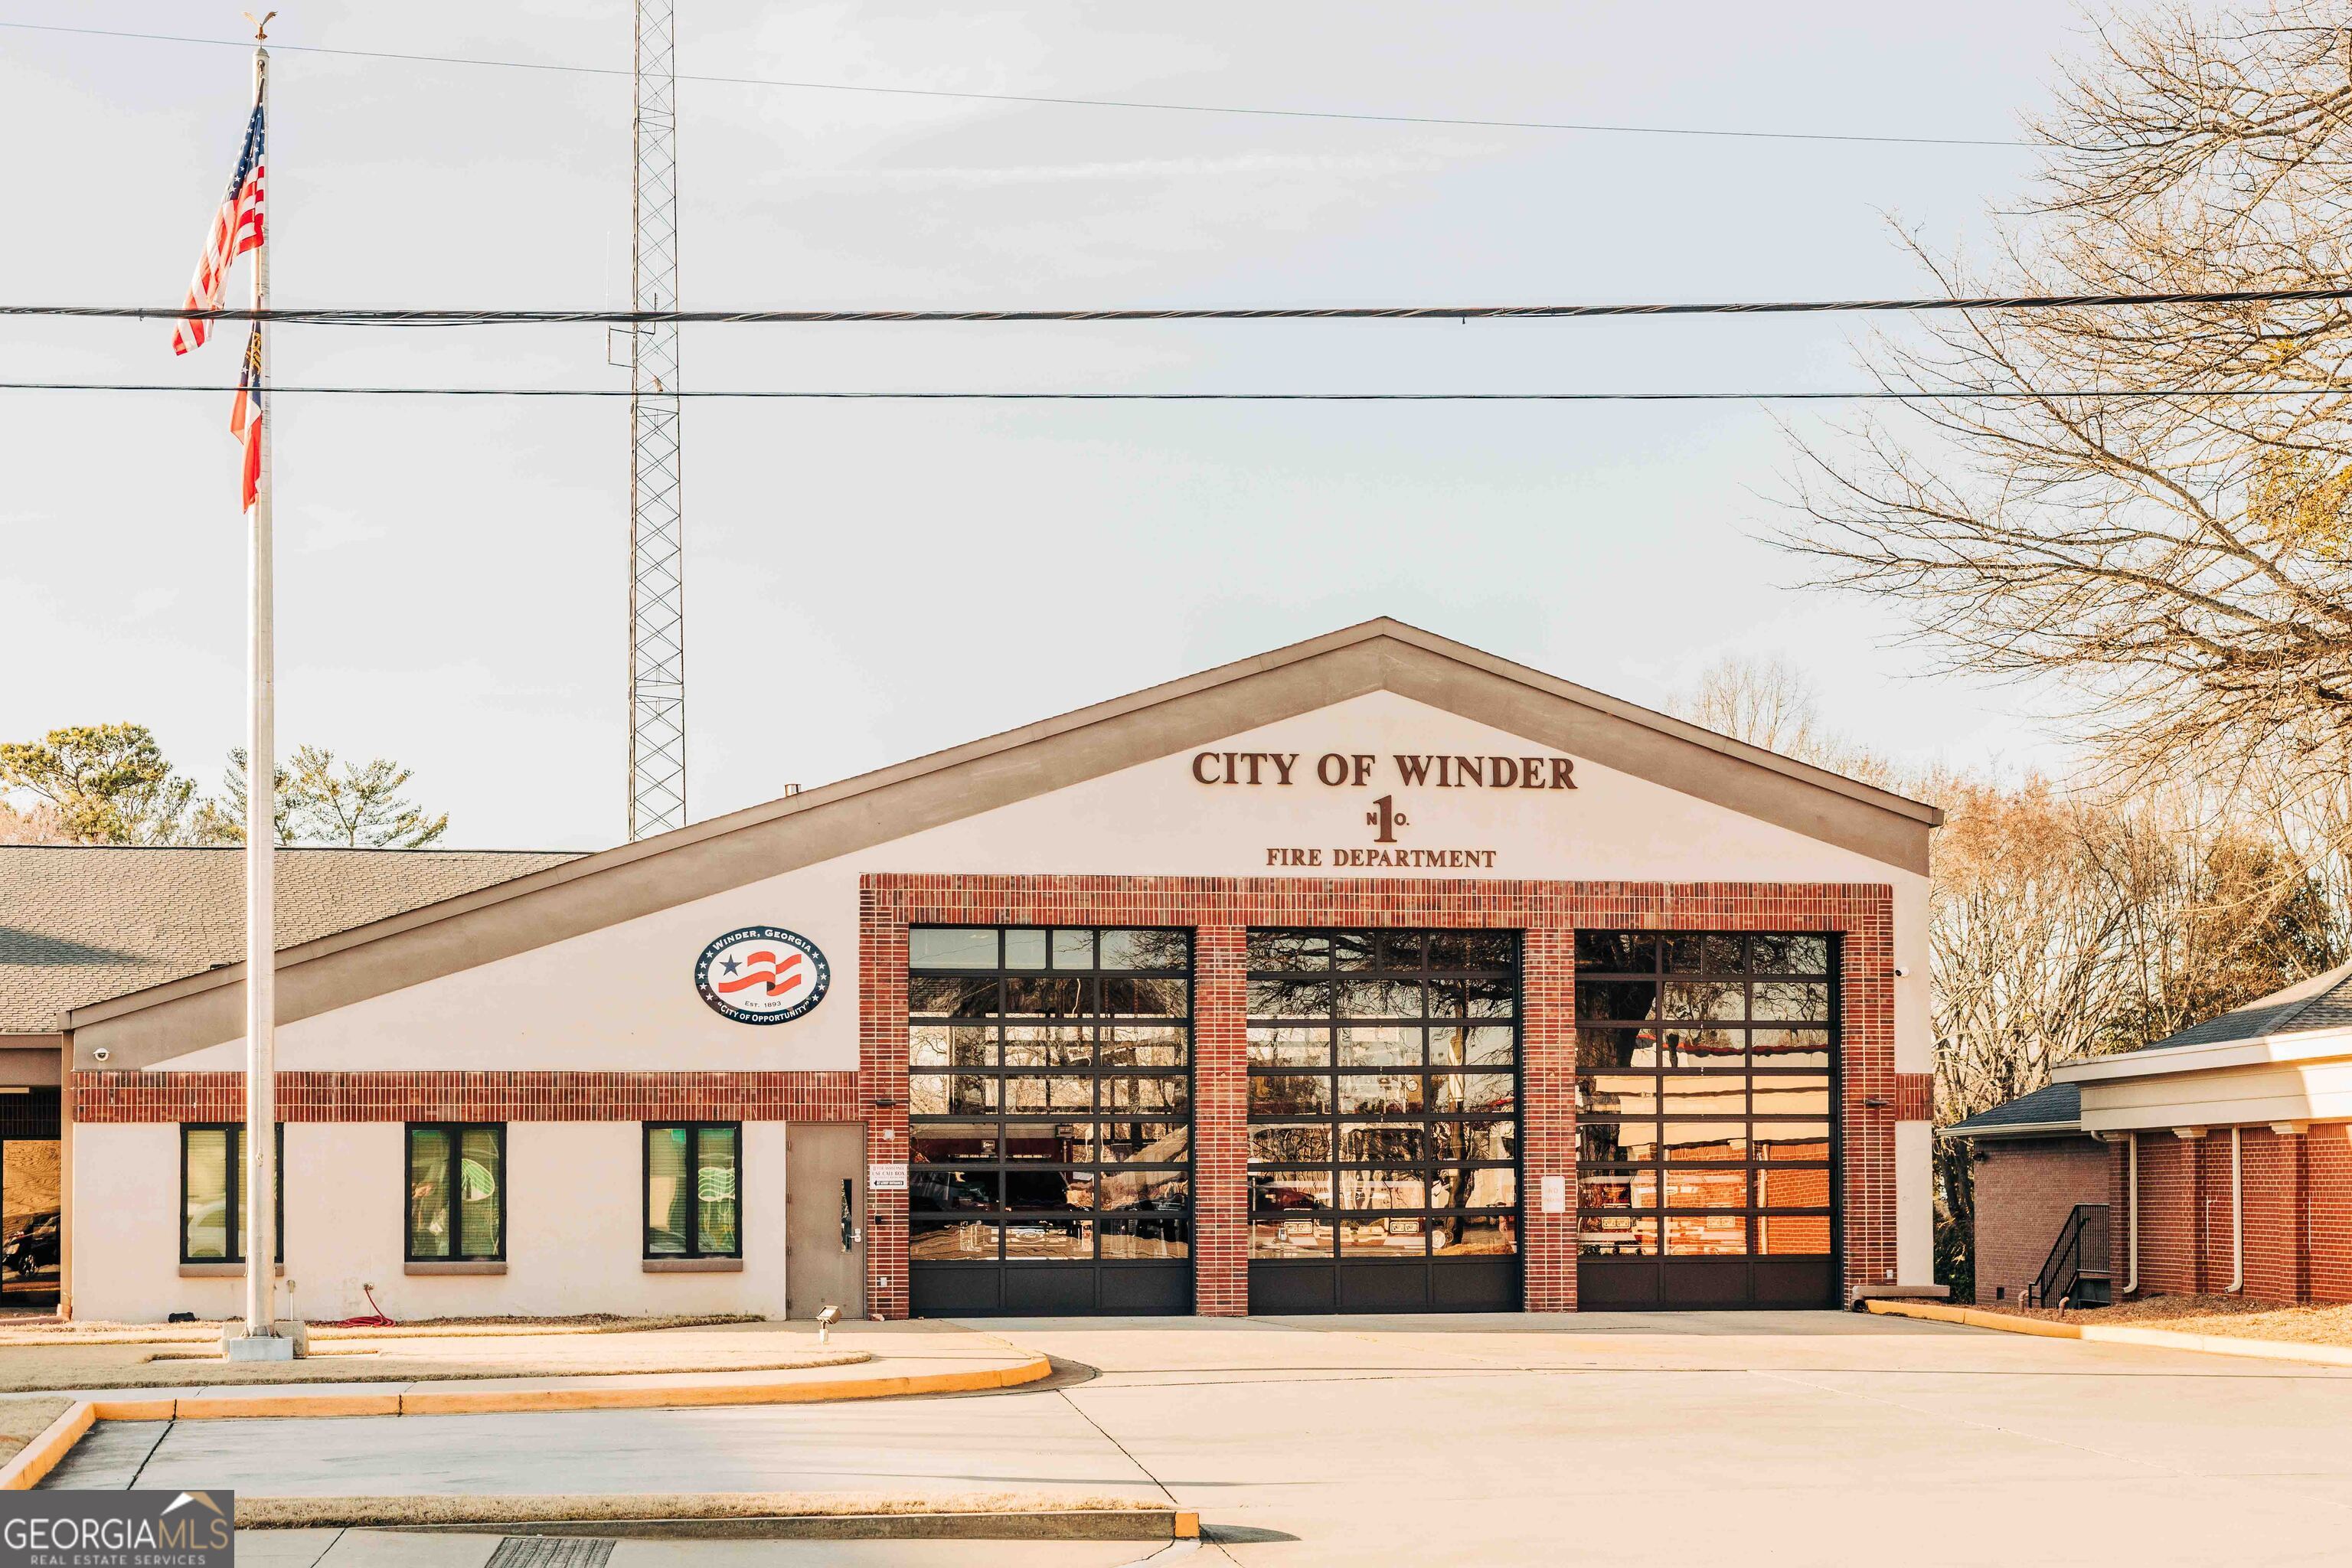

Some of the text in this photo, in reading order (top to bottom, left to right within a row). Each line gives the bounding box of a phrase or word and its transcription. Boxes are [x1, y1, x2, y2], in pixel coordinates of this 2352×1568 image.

[1192, 752, 1579, 789] CITY OF WINDER
[1266, 848, 1497, 867] FIRE DEPARTMENT
[712, 929, 812, 952] WINDER, GEORGIA
